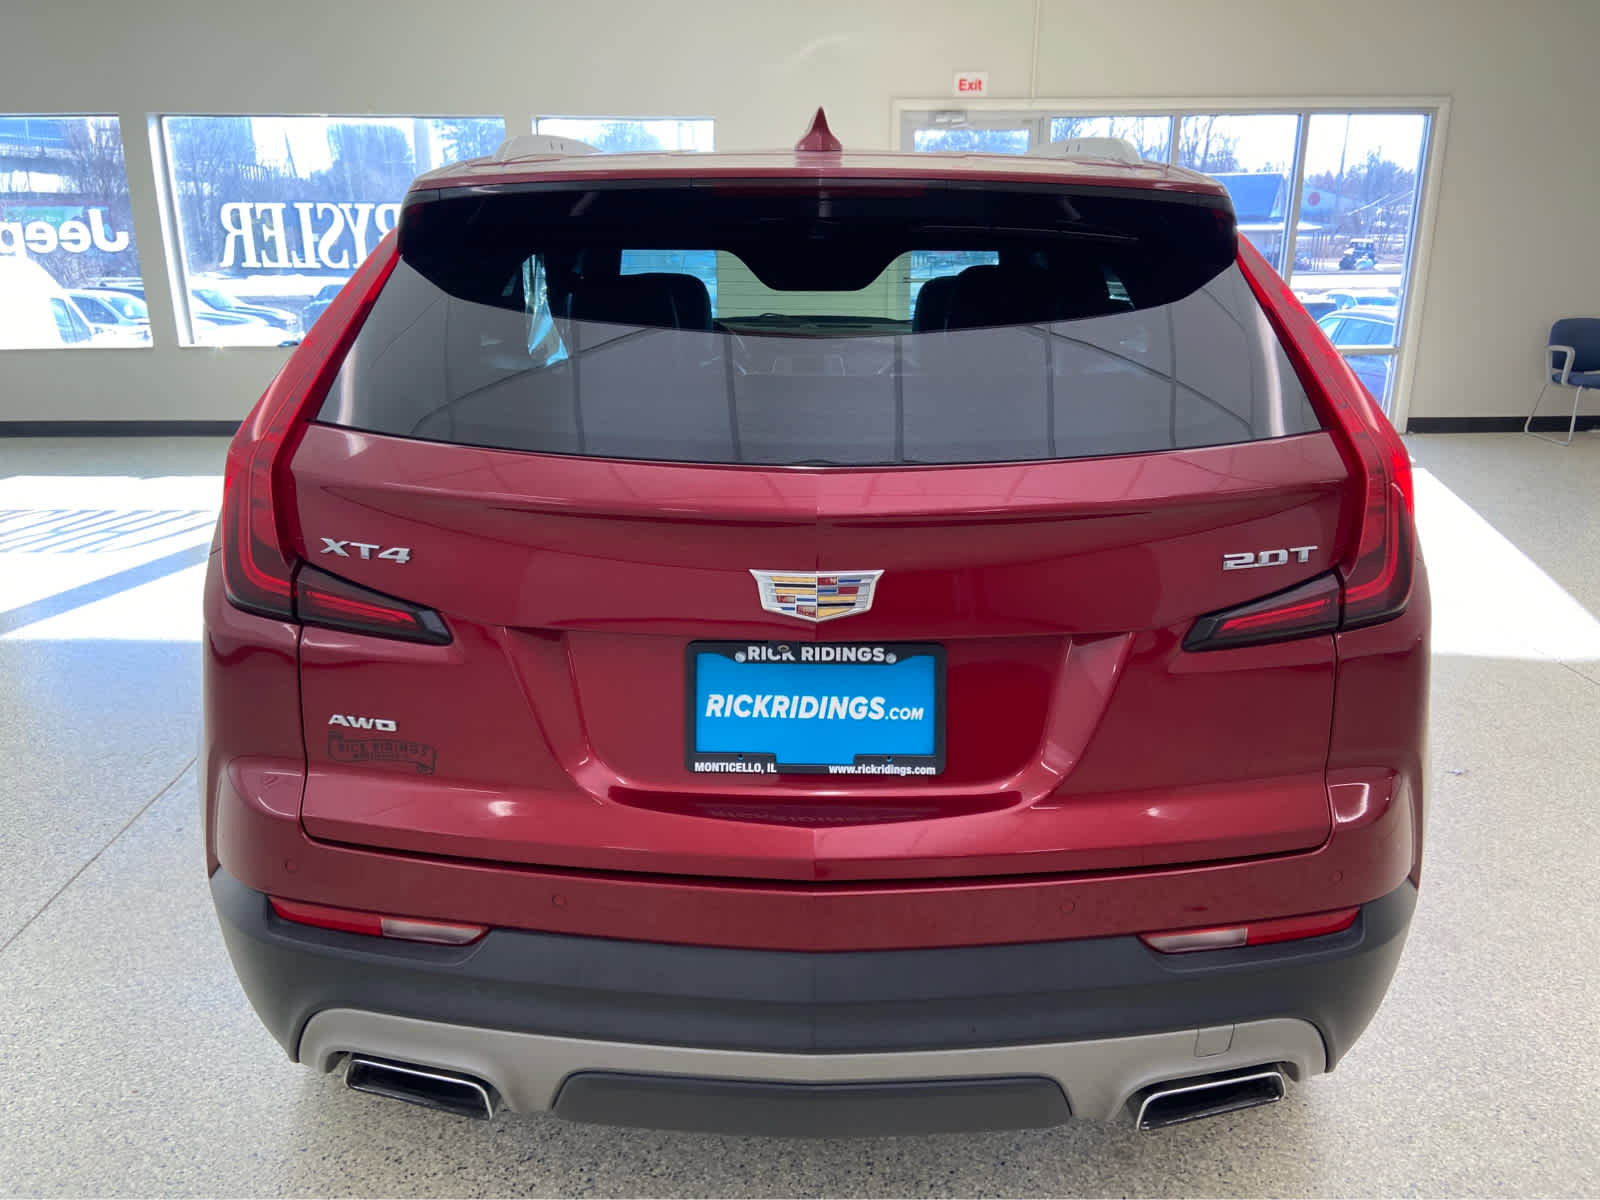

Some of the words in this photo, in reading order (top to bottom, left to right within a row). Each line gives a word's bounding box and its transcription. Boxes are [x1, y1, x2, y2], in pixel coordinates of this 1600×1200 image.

[958, 78, 983, 92] Exit
[320, 537, 410, 564] XT4
[1223, 545, 1318, 570] 2.0T
[747, 645, 796, 662] RICK
[801, 647, 886, 663] RIDINGS
[705, 694, 924, 721] RICKRIDINGS.COM
[328, 713, 398, 732] AWD
[694, 762, 764, 775] MONTICELLO,
[766, 763, 777, 773] IL
[828, 764, 936, 777] www.rickridings.com
